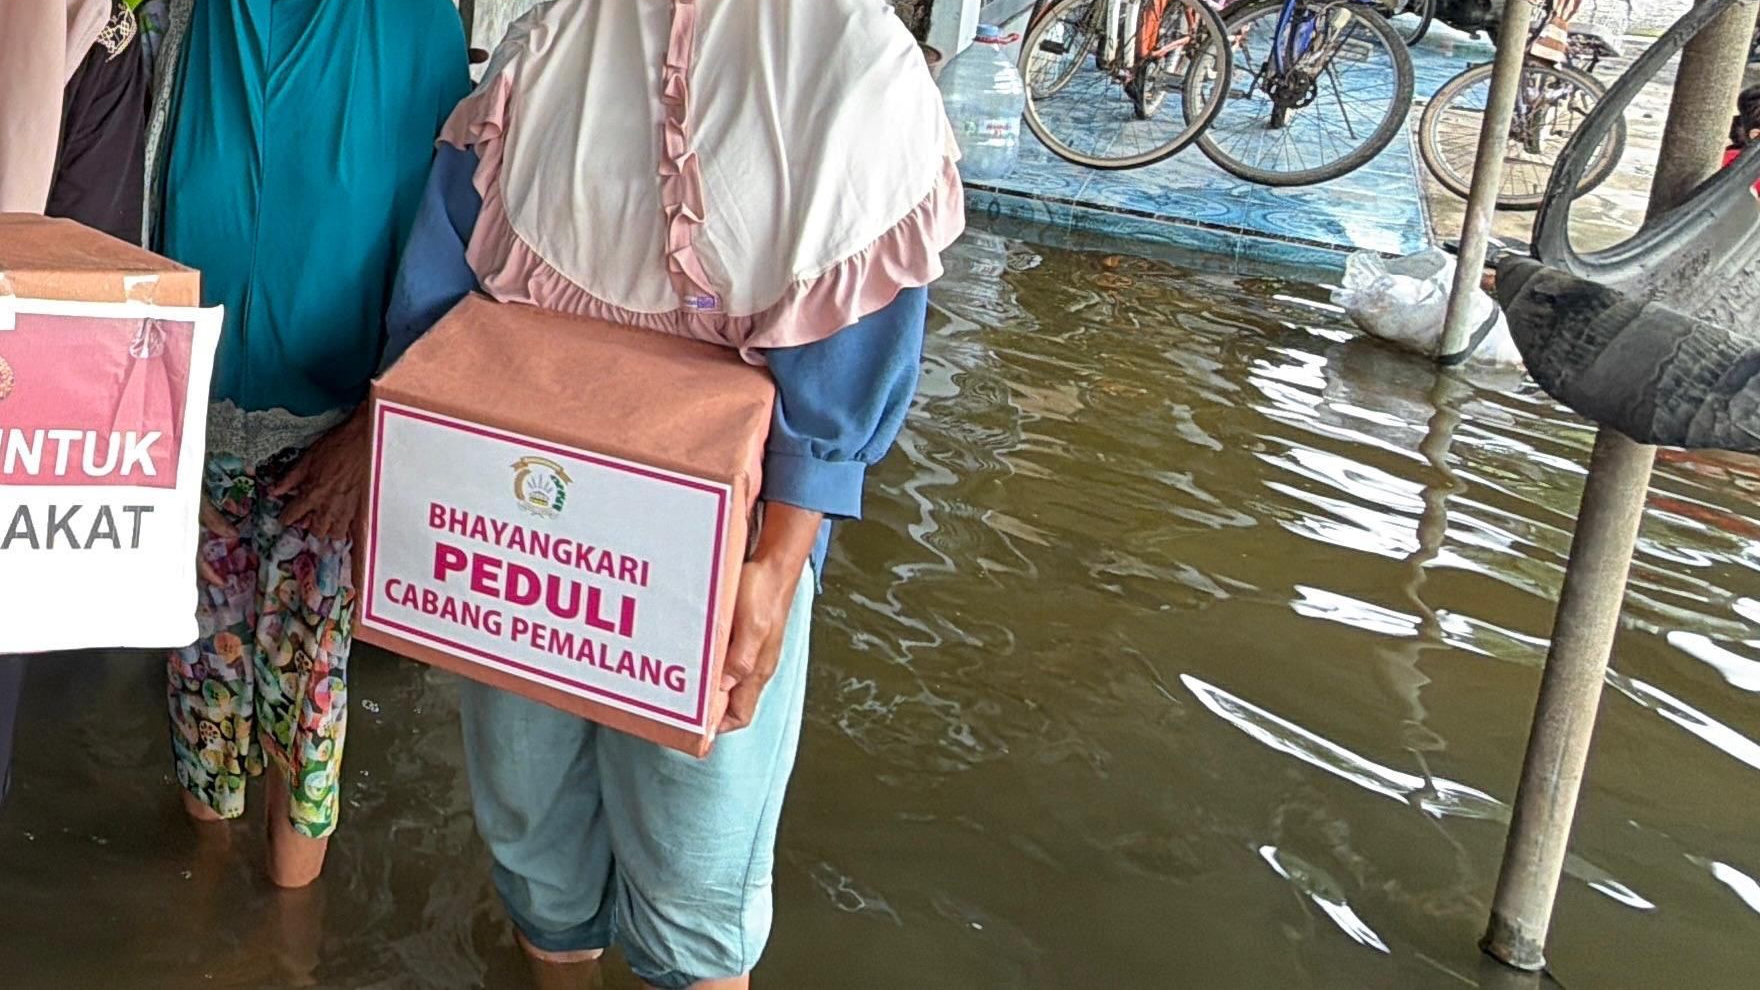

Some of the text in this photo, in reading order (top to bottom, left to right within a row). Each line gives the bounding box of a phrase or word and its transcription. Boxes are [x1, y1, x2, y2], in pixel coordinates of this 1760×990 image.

[428, 501, 650, 587] BHAYANGKARI
[433, 541, 636, 639] PEDULI
[384, 578, 687, 693] CABANG PEMALANG
